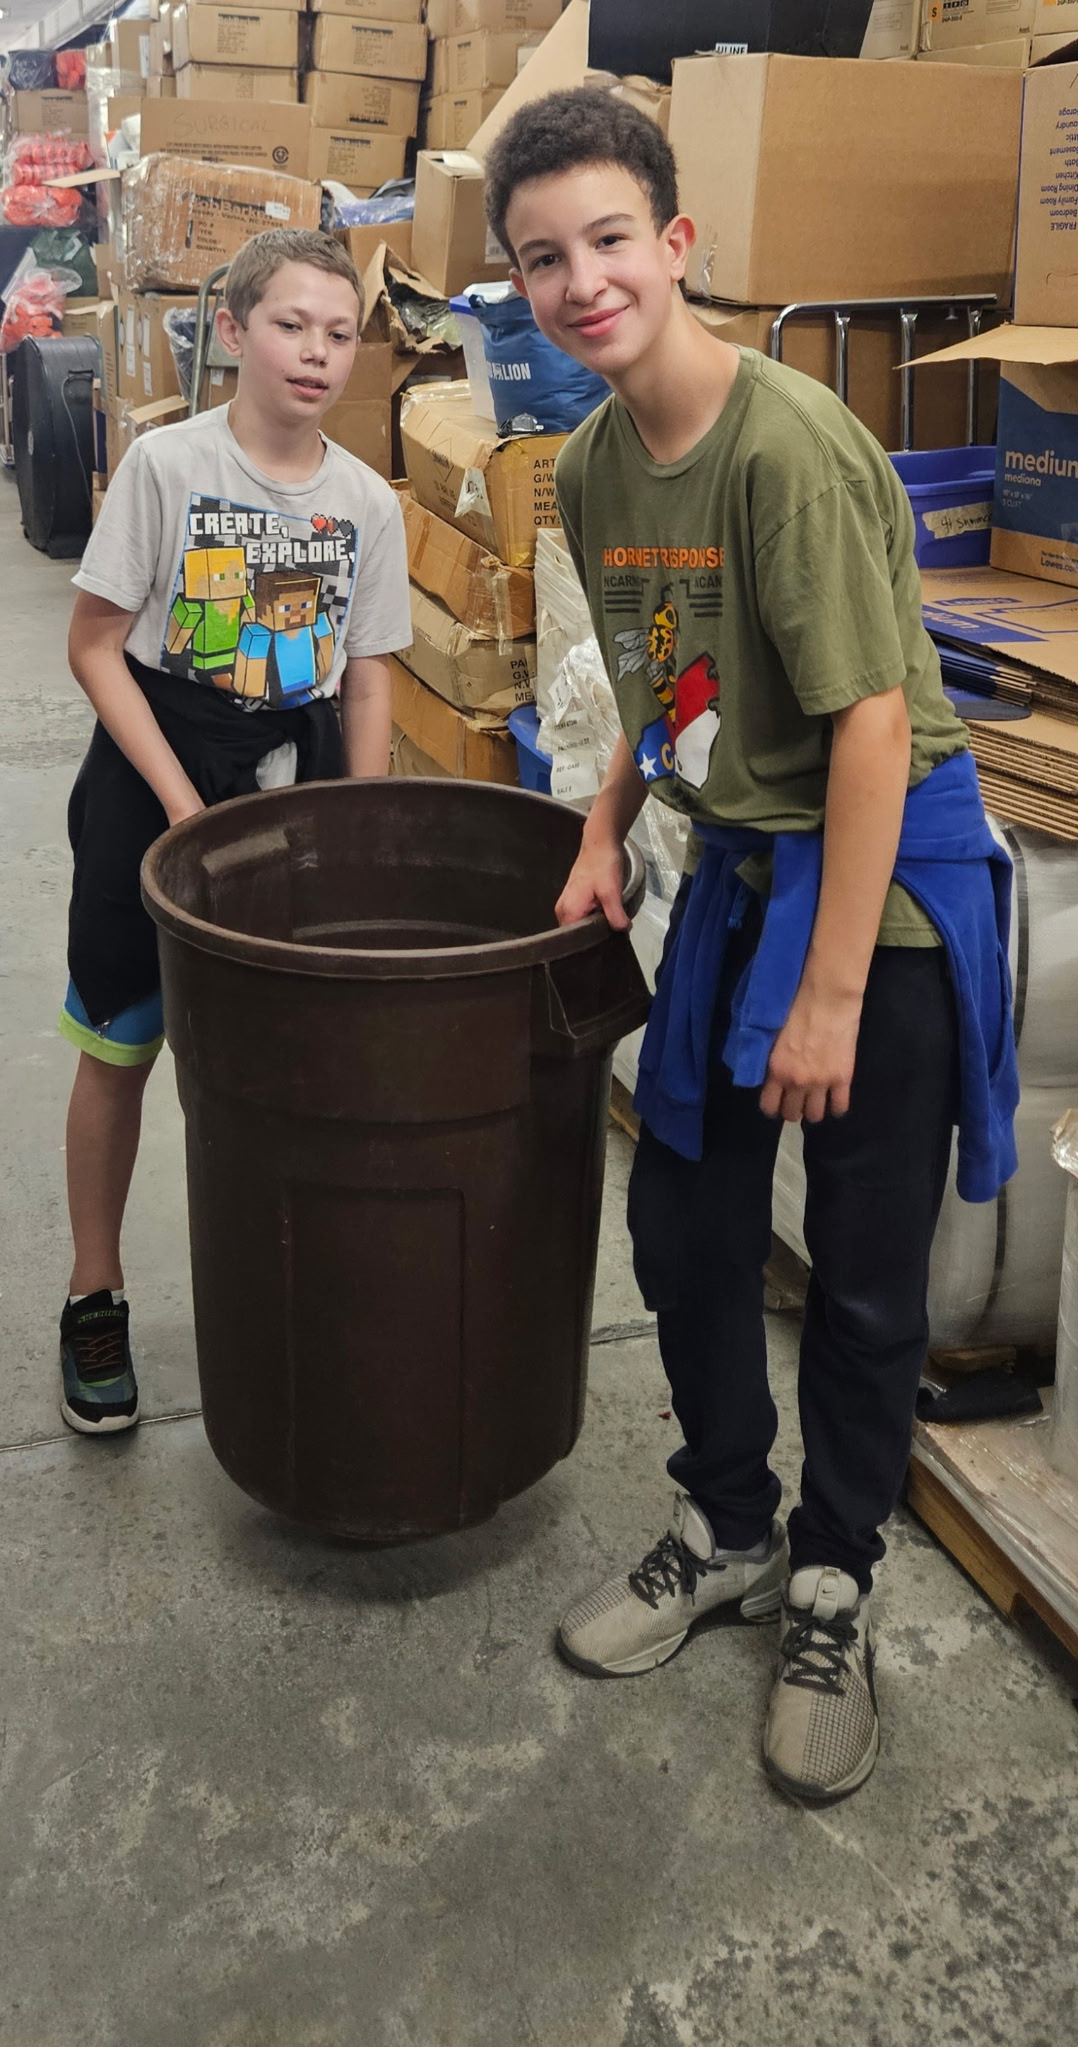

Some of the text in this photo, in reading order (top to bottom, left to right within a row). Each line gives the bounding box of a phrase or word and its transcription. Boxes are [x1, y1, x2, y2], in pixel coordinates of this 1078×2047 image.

[931, 7, 938, 18] S
[1049, 209, 1078, 217] Bedroom
[1050, 222, 1078, 231] FRAGILE
[1004, 473, 1041, 487] mediana
[189, 512, 290, 538] CREATE,
[246, 538, 356, 565] EXPLORE,
[661, 742, 675, 771] C
